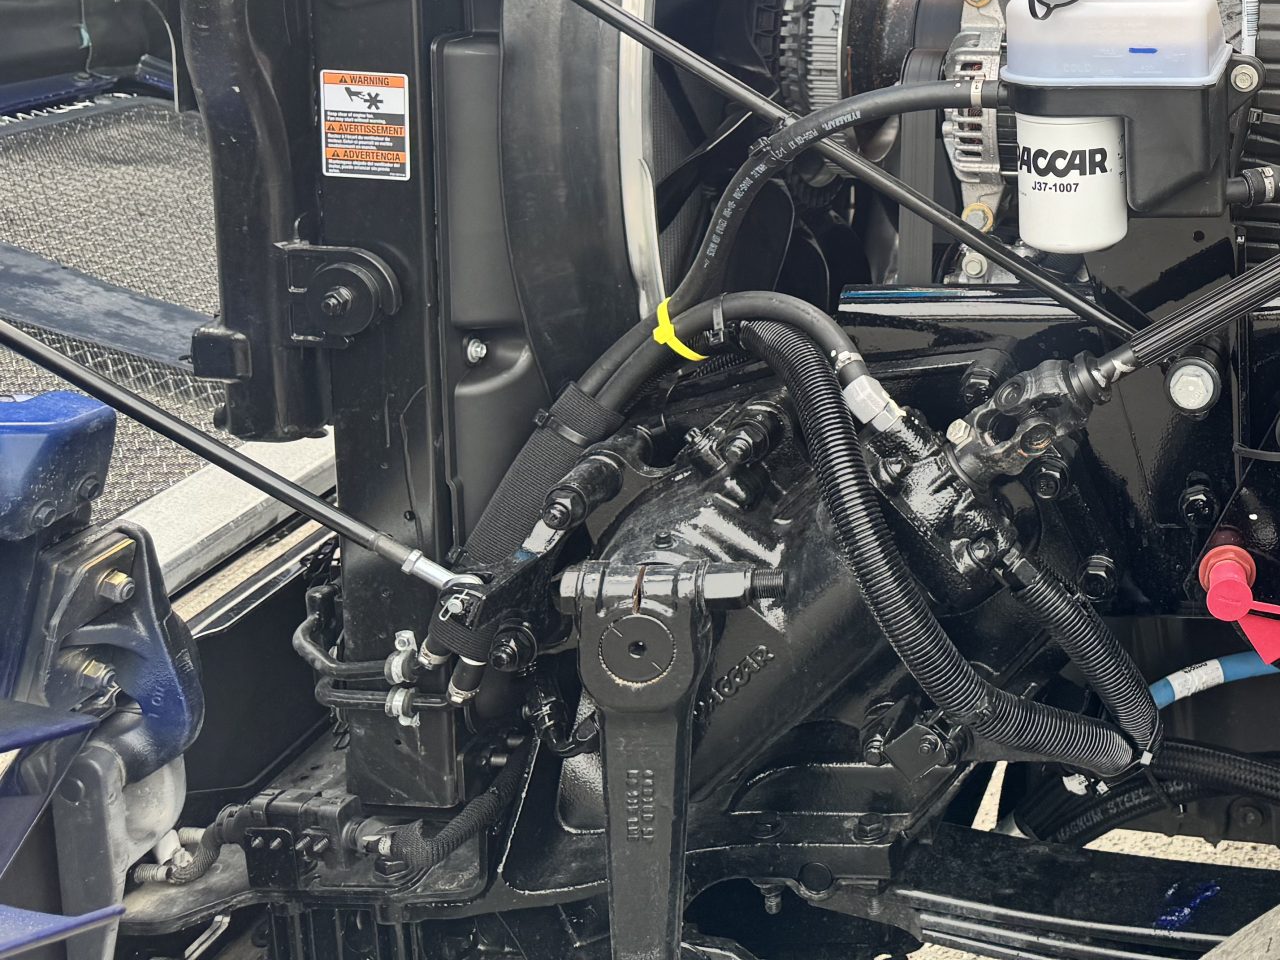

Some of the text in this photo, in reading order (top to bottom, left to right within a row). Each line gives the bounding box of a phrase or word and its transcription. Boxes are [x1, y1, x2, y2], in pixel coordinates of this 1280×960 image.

[350, 76, 390, 86] WARNING
[339, 124, 404, 135] AVERTISSEMENT
[344, 150, 401, 162] ADVERTENCIA
[1017, 145, 1108, 178] ACCAR
[1032, 181, 1080, 193] J37-1007
[1107, 788, 1151, 814] STEEL
